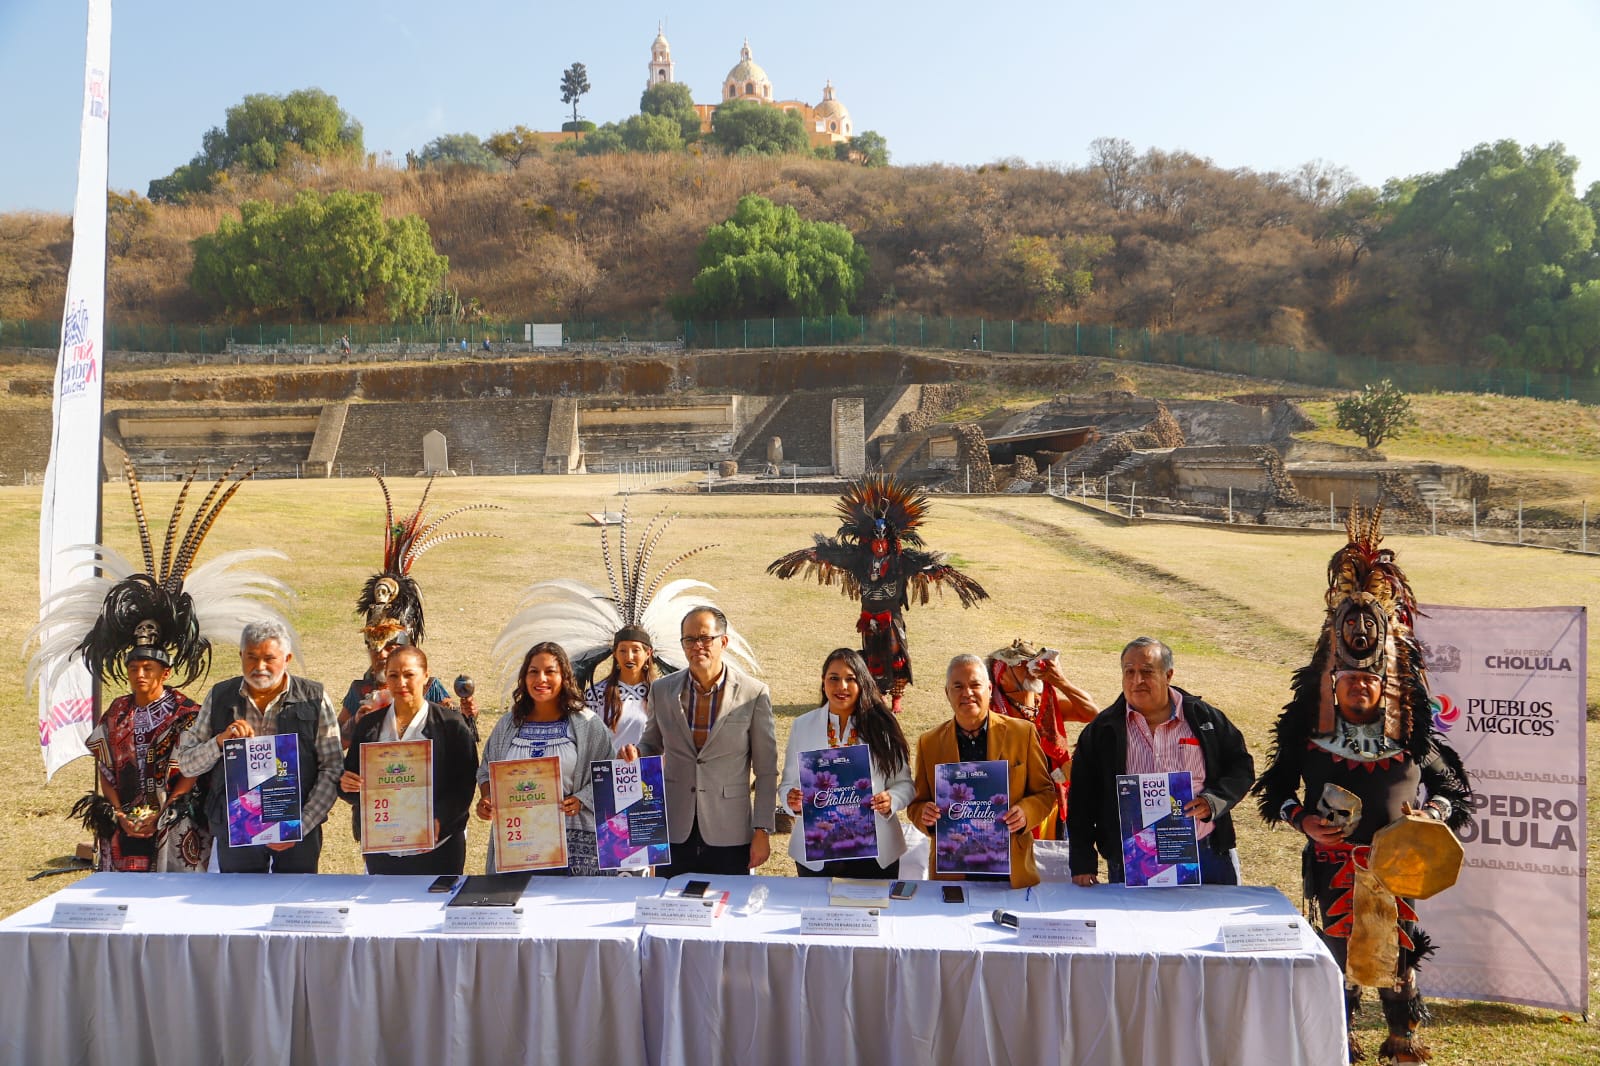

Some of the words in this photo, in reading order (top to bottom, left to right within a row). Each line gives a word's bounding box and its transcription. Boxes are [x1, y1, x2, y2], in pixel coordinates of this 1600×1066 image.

[1504, 648, 1521, 656] SAN
[1523, 649, 1552, 658] PEDRO
[1485, 655, 1572, 672] CHOLULA
[250, 743, 271, 752] EQUI
[250, 752, 272, 761] NOC
[278, 769, 288, 777] 23
[615, 766, 637, 775] EQUI
[378, 775, 416, 785] PULQUE
[616, 775, 638, 784] NOC
[1142, 780, 1165, 789] EQUI
[509, 792, 546, 803] PULQUE
[644, 793, 654, 801] 23
[1143, 788, 1166, 798] NOC
[374, 798, 389, 810] 20
[814, 790, 861, 809] Cholula
[948, 802, 996, 820] Cholula
[1172, 808, 1182, 816] 23
[1470, 793, 1578, 822] PEDRO
[374, 812, 389, 822] 23
[506, 817, 521, 828] 20
[507, 830, 522, 841] 23
[1455, 818, 1577, 852] OLULA
